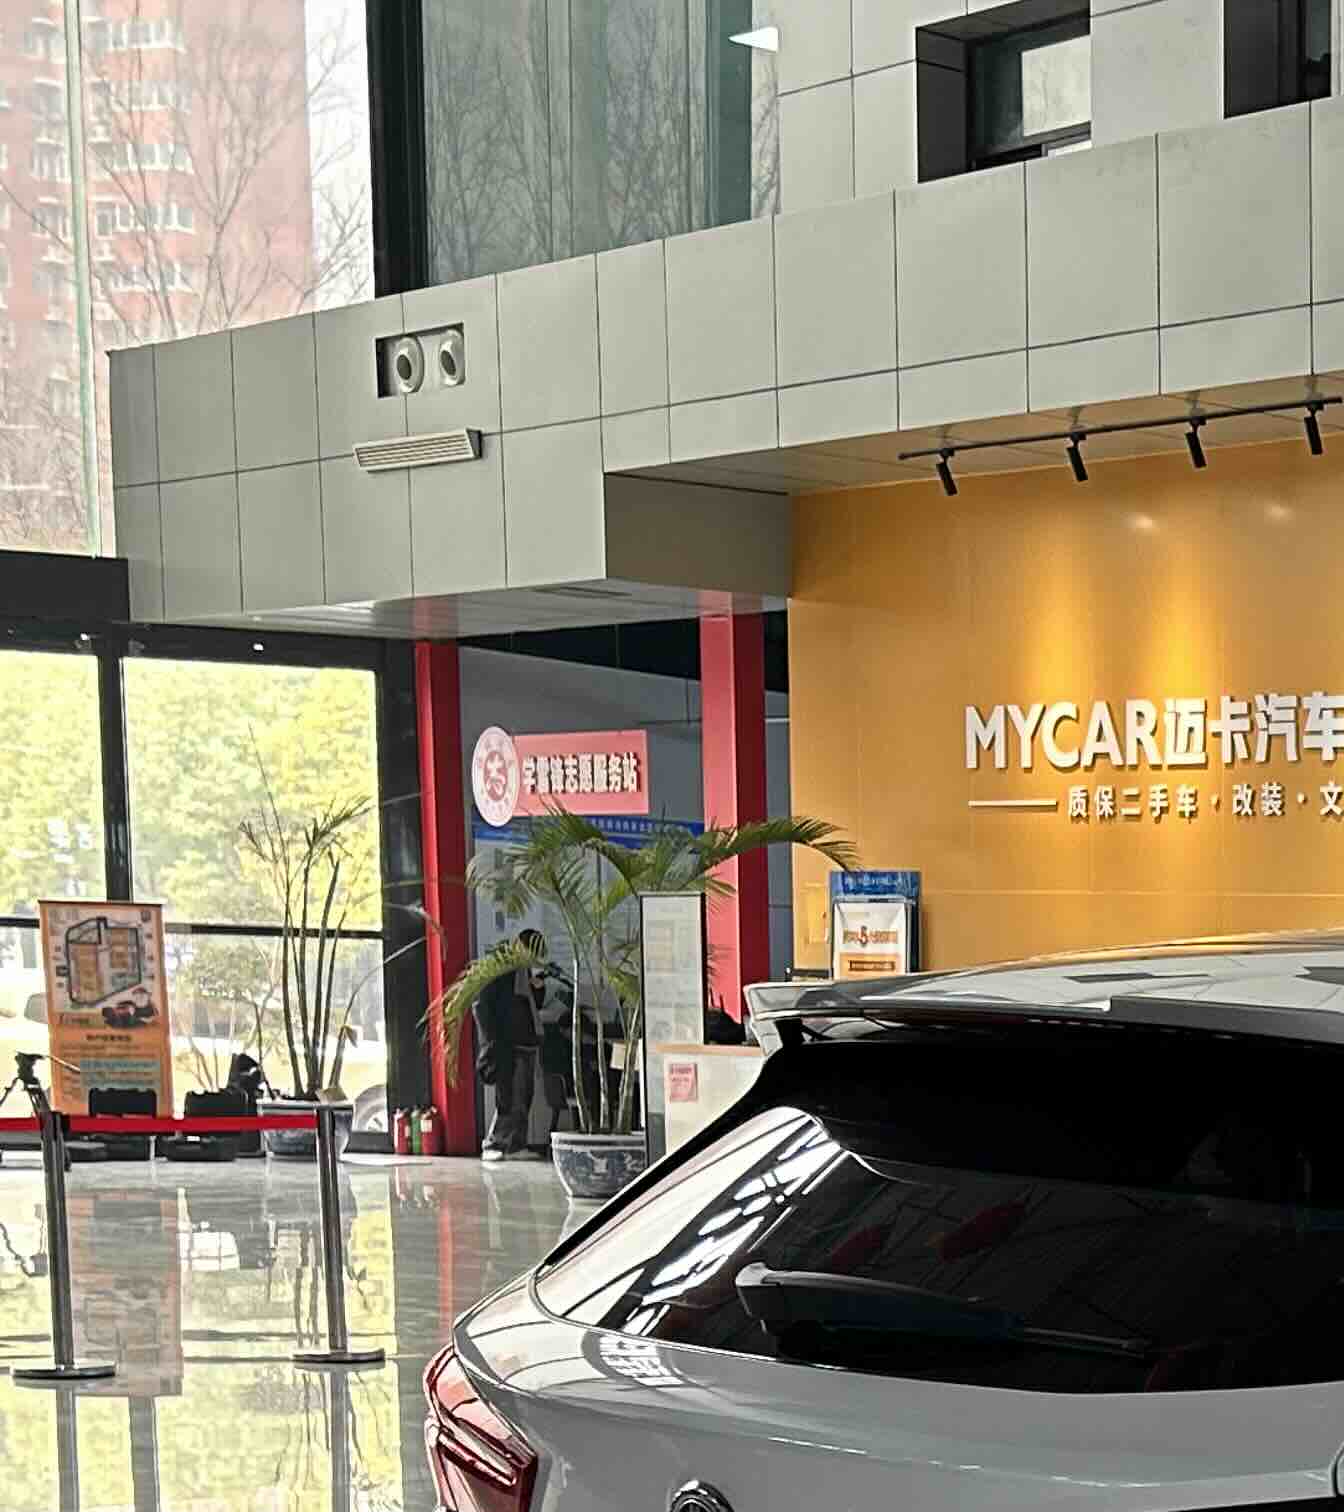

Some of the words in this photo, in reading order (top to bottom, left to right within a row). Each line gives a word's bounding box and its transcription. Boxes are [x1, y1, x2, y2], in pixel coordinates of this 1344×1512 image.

[522, 751, 640, 794] 学雷锋志愿服务站
